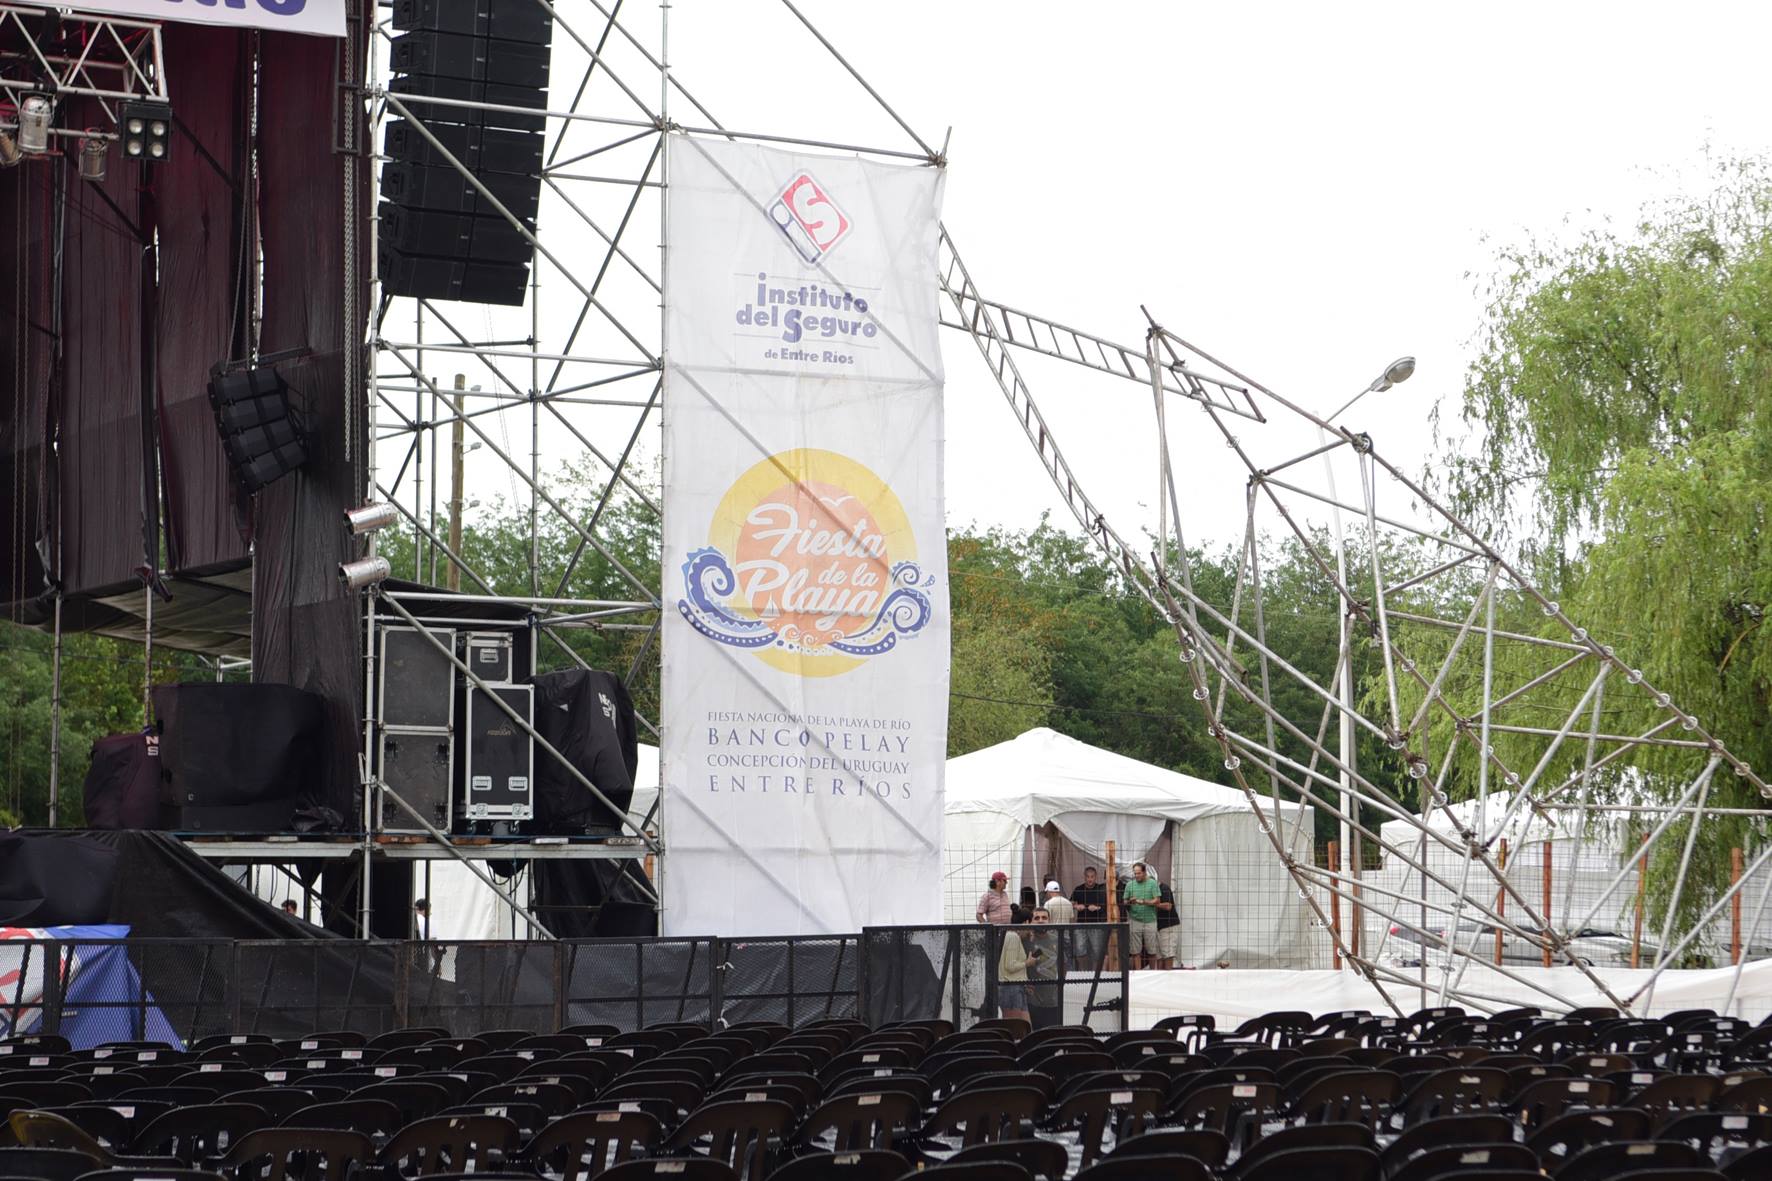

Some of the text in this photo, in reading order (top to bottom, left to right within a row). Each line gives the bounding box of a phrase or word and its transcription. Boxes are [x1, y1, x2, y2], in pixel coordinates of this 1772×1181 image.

[736, 304, 877, 343] del Seguro
[764, 348, 778, 360] de
[781, 347, 819, 362] Entre
[747, 503, 887, 558] Fiesta
[818, 561, 879, 588] de la
[735, 560, 881, 631] Playa
[708, 711, 744, 722] FIESTA
[747, 712, 803, 724] NACIONA
[807, 714, 821, 725] DE
[824, 716, 836, 727] LA
[839, 717, 870, 729] PLAYA
[873, 719, 888, 730] DE
[708, 727, 910, 753] BANCO PELAY
[809, 757, 838, 770] DEL
[843, 758, 910, 774] URUGUAY
[709, 774, 815, 794] ENTRE
